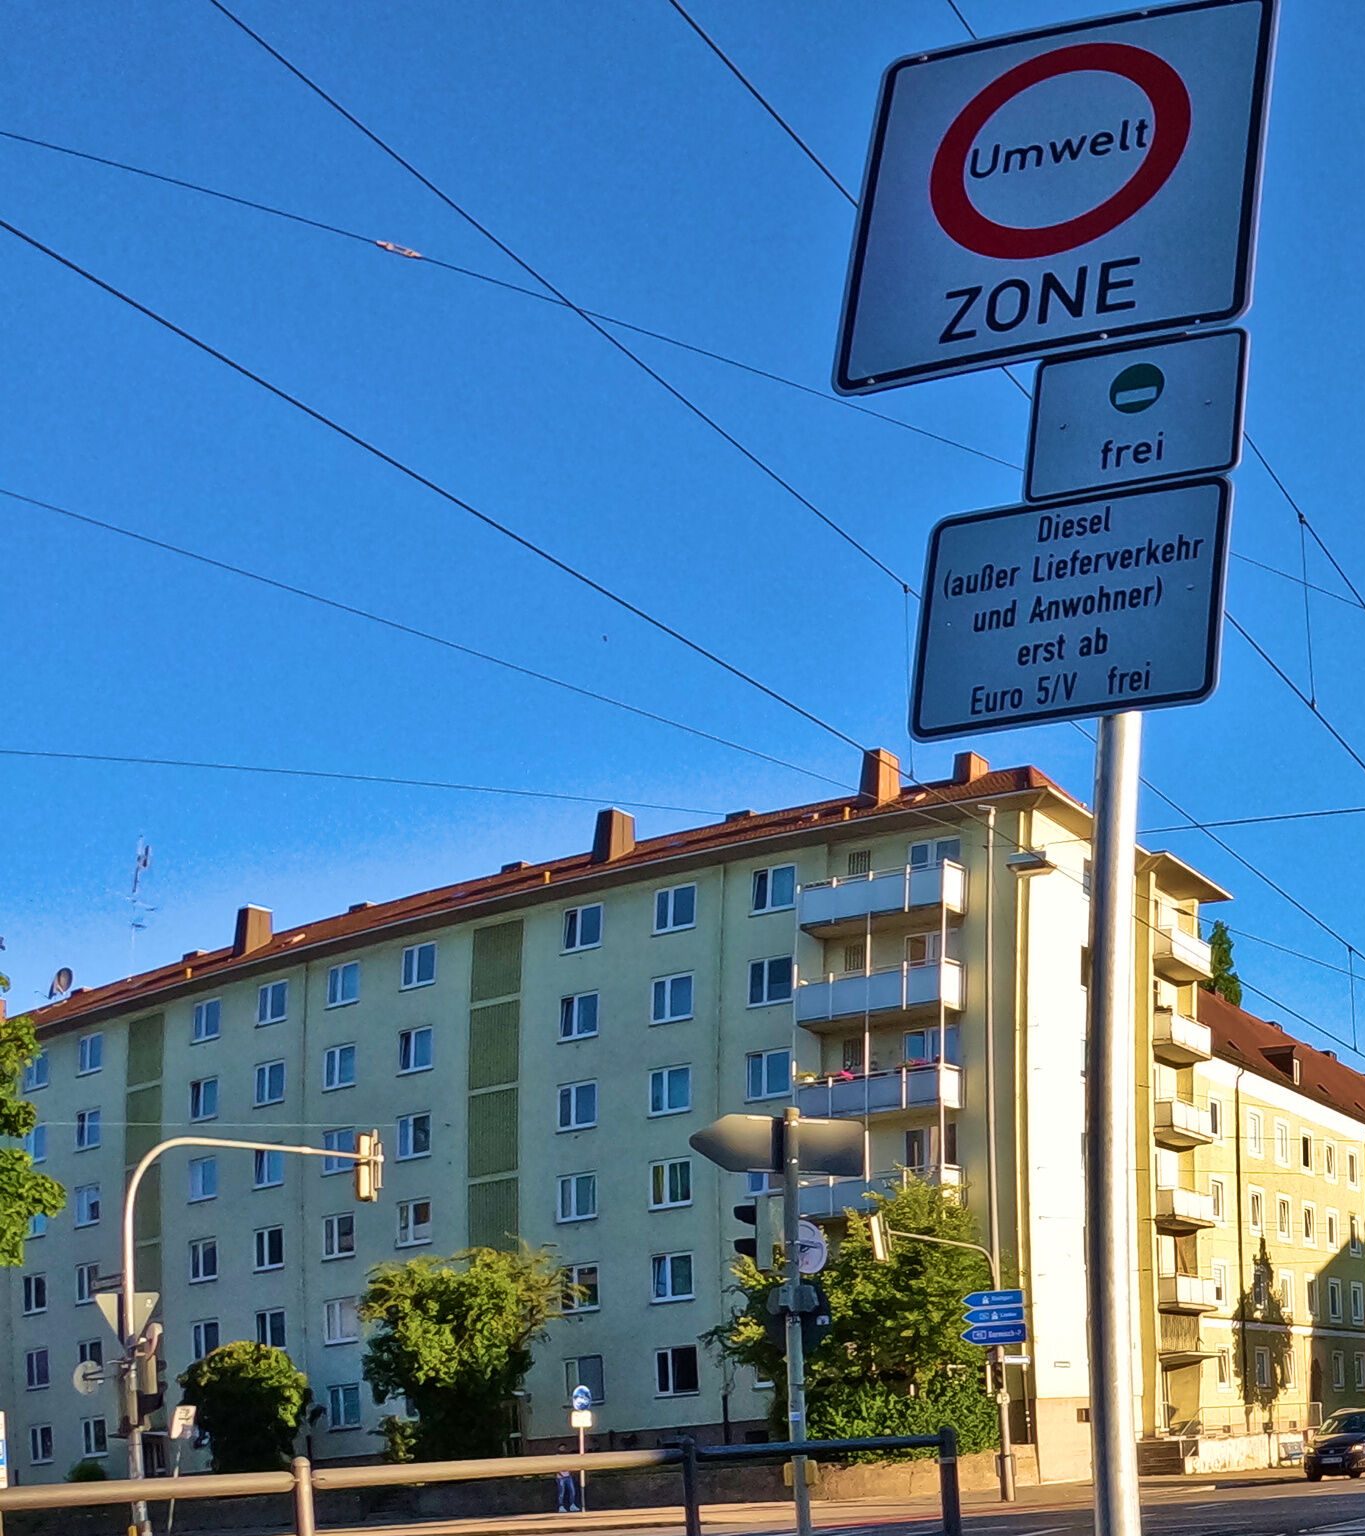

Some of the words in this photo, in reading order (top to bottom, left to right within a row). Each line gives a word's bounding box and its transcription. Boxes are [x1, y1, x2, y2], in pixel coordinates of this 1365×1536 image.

[969, 119, 1149, 179] Umwelt
[937, 256, 1141, 344] ZONE
[1100, 431, 1164, 471] frei
[1037, 505, 1112, 543] Diesel
[944, 563, 1021, 601] (außer
[1032, 533, 1205, 584] Lieferverkehr
[973, 600, 1017, 633] und
[1028, 575, 1164, 624] Anwohner)
[1017, 633, 1067, 667] erst
[1078, 627, 1109, 658] ab
[970, 685, 1024, 716] Euro
[1036, 671, 1078, 705] 5/V
[1107, 661, 1152, 695] frei
